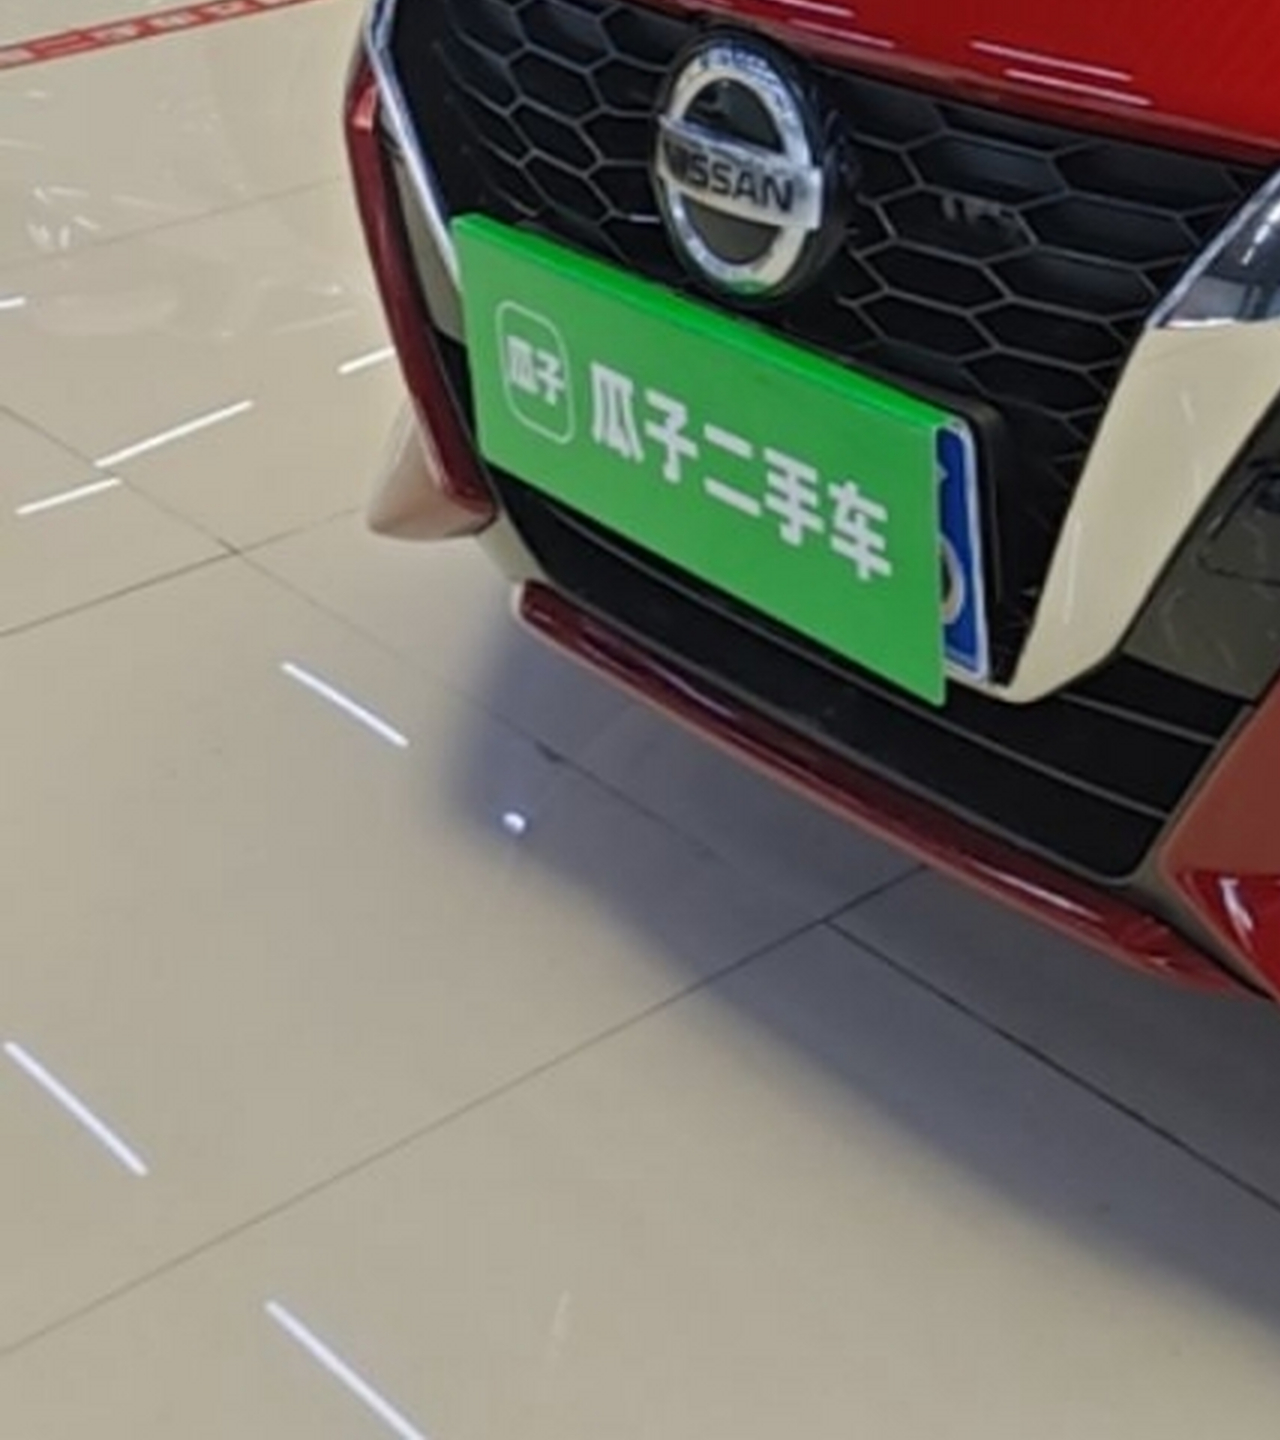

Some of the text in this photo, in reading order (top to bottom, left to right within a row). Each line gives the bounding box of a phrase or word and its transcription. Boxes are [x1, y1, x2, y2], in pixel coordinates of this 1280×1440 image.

[664, 137, 794, 214] NISSAN
[590, 361, 893, 583] 瓜子二手车
